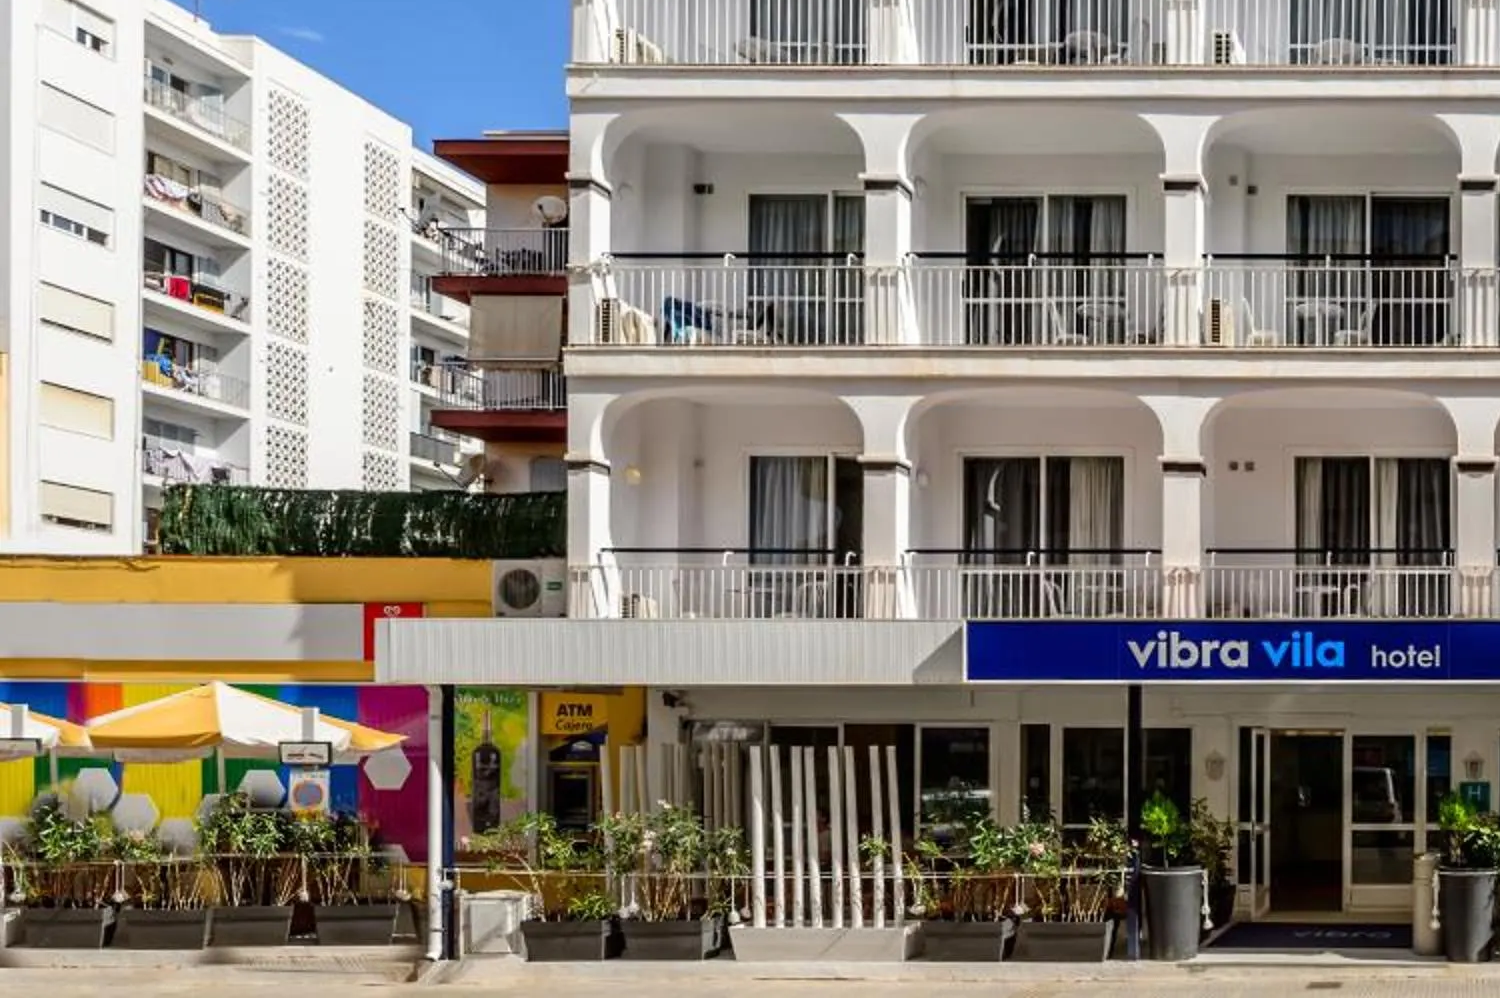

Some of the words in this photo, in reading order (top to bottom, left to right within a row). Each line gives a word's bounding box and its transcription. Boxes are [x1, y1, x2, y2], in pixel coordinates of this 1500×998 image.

[1127, 630, 1249, 669] vibra
[1261, 630, 1345, 669] vila
[1370, 645, 1441, 668] hotel
[556, 703, 593, 717] ATM
[1467, 785, 1481, 801] H
